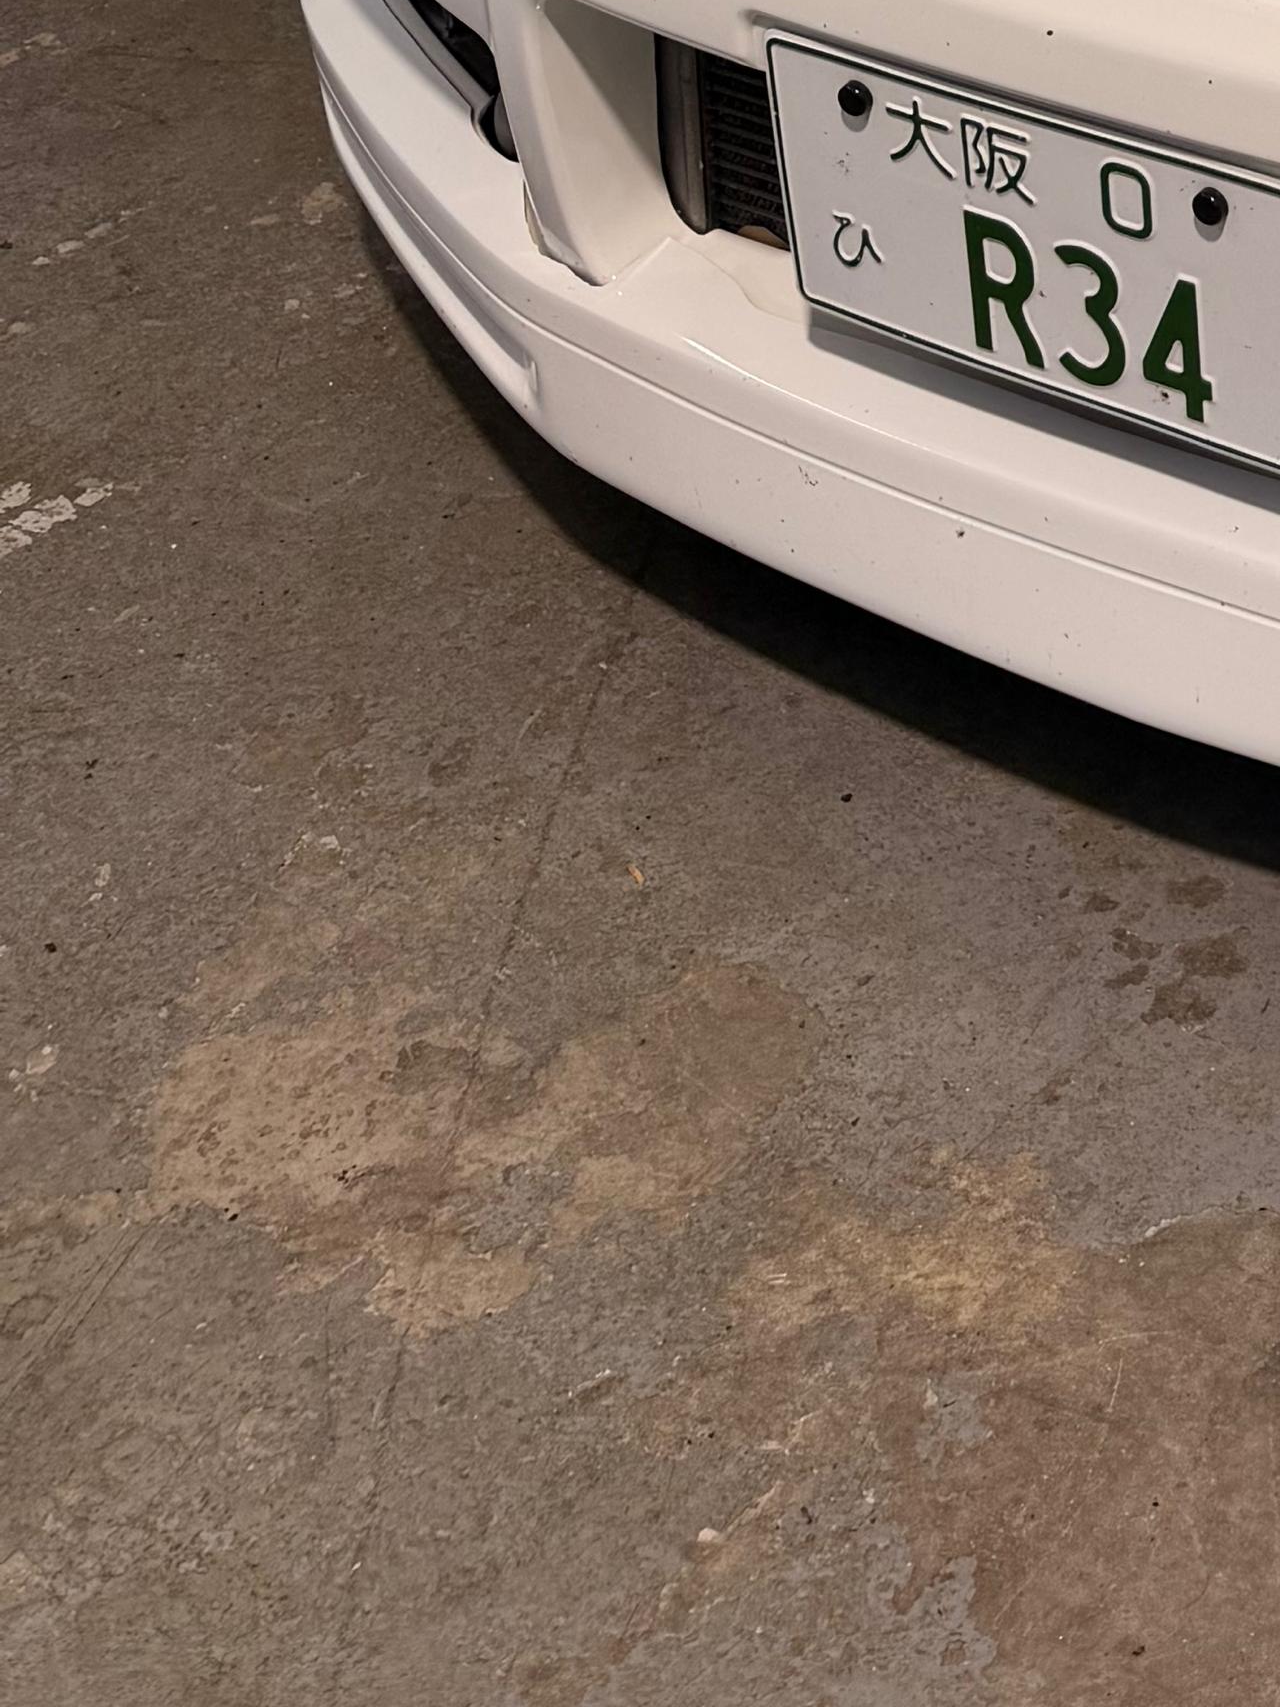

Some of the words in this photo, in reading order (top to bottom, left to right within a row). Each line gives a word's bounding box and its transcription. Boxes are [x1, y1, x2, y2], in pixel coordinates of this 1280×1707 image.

[886, 100, 1034, 206] 大阪
[833, 214, 882, 269] ひ
[963, 209, 1213, 424] R34
